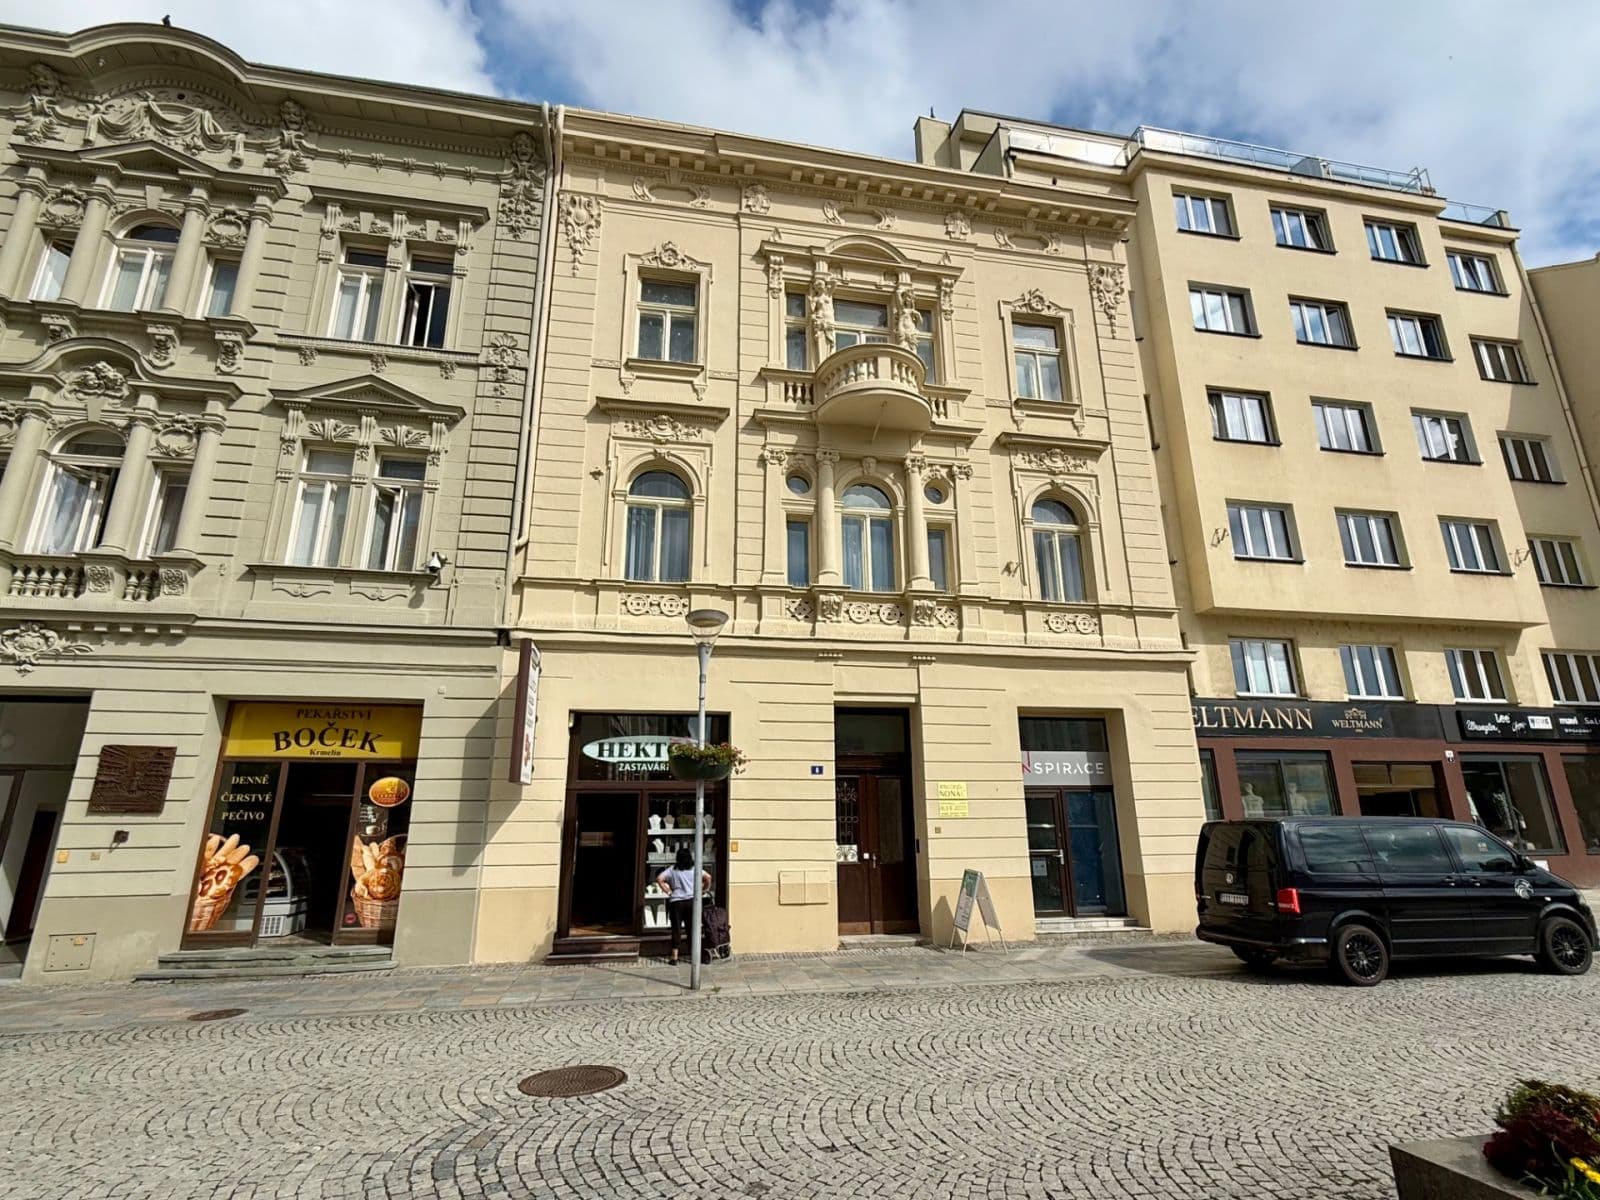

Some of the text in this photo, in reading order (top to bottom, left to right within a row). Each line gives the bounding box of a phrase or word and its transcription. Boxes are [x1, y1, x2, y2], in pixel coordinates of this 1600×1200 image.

[296, 708, 373, 720] PEKAŘSTVÍ
[1494, 713, 1510, 724] Lee
[1331, 718, 1383, 729] WELTMANN
[272, 721, 384, 754] BOČEK
[231, 774, 270, 785] DENNĚ
[220, 791, 272, 803] ČERSTVÉ
[220, 810, 265, 821] PEČIVO
